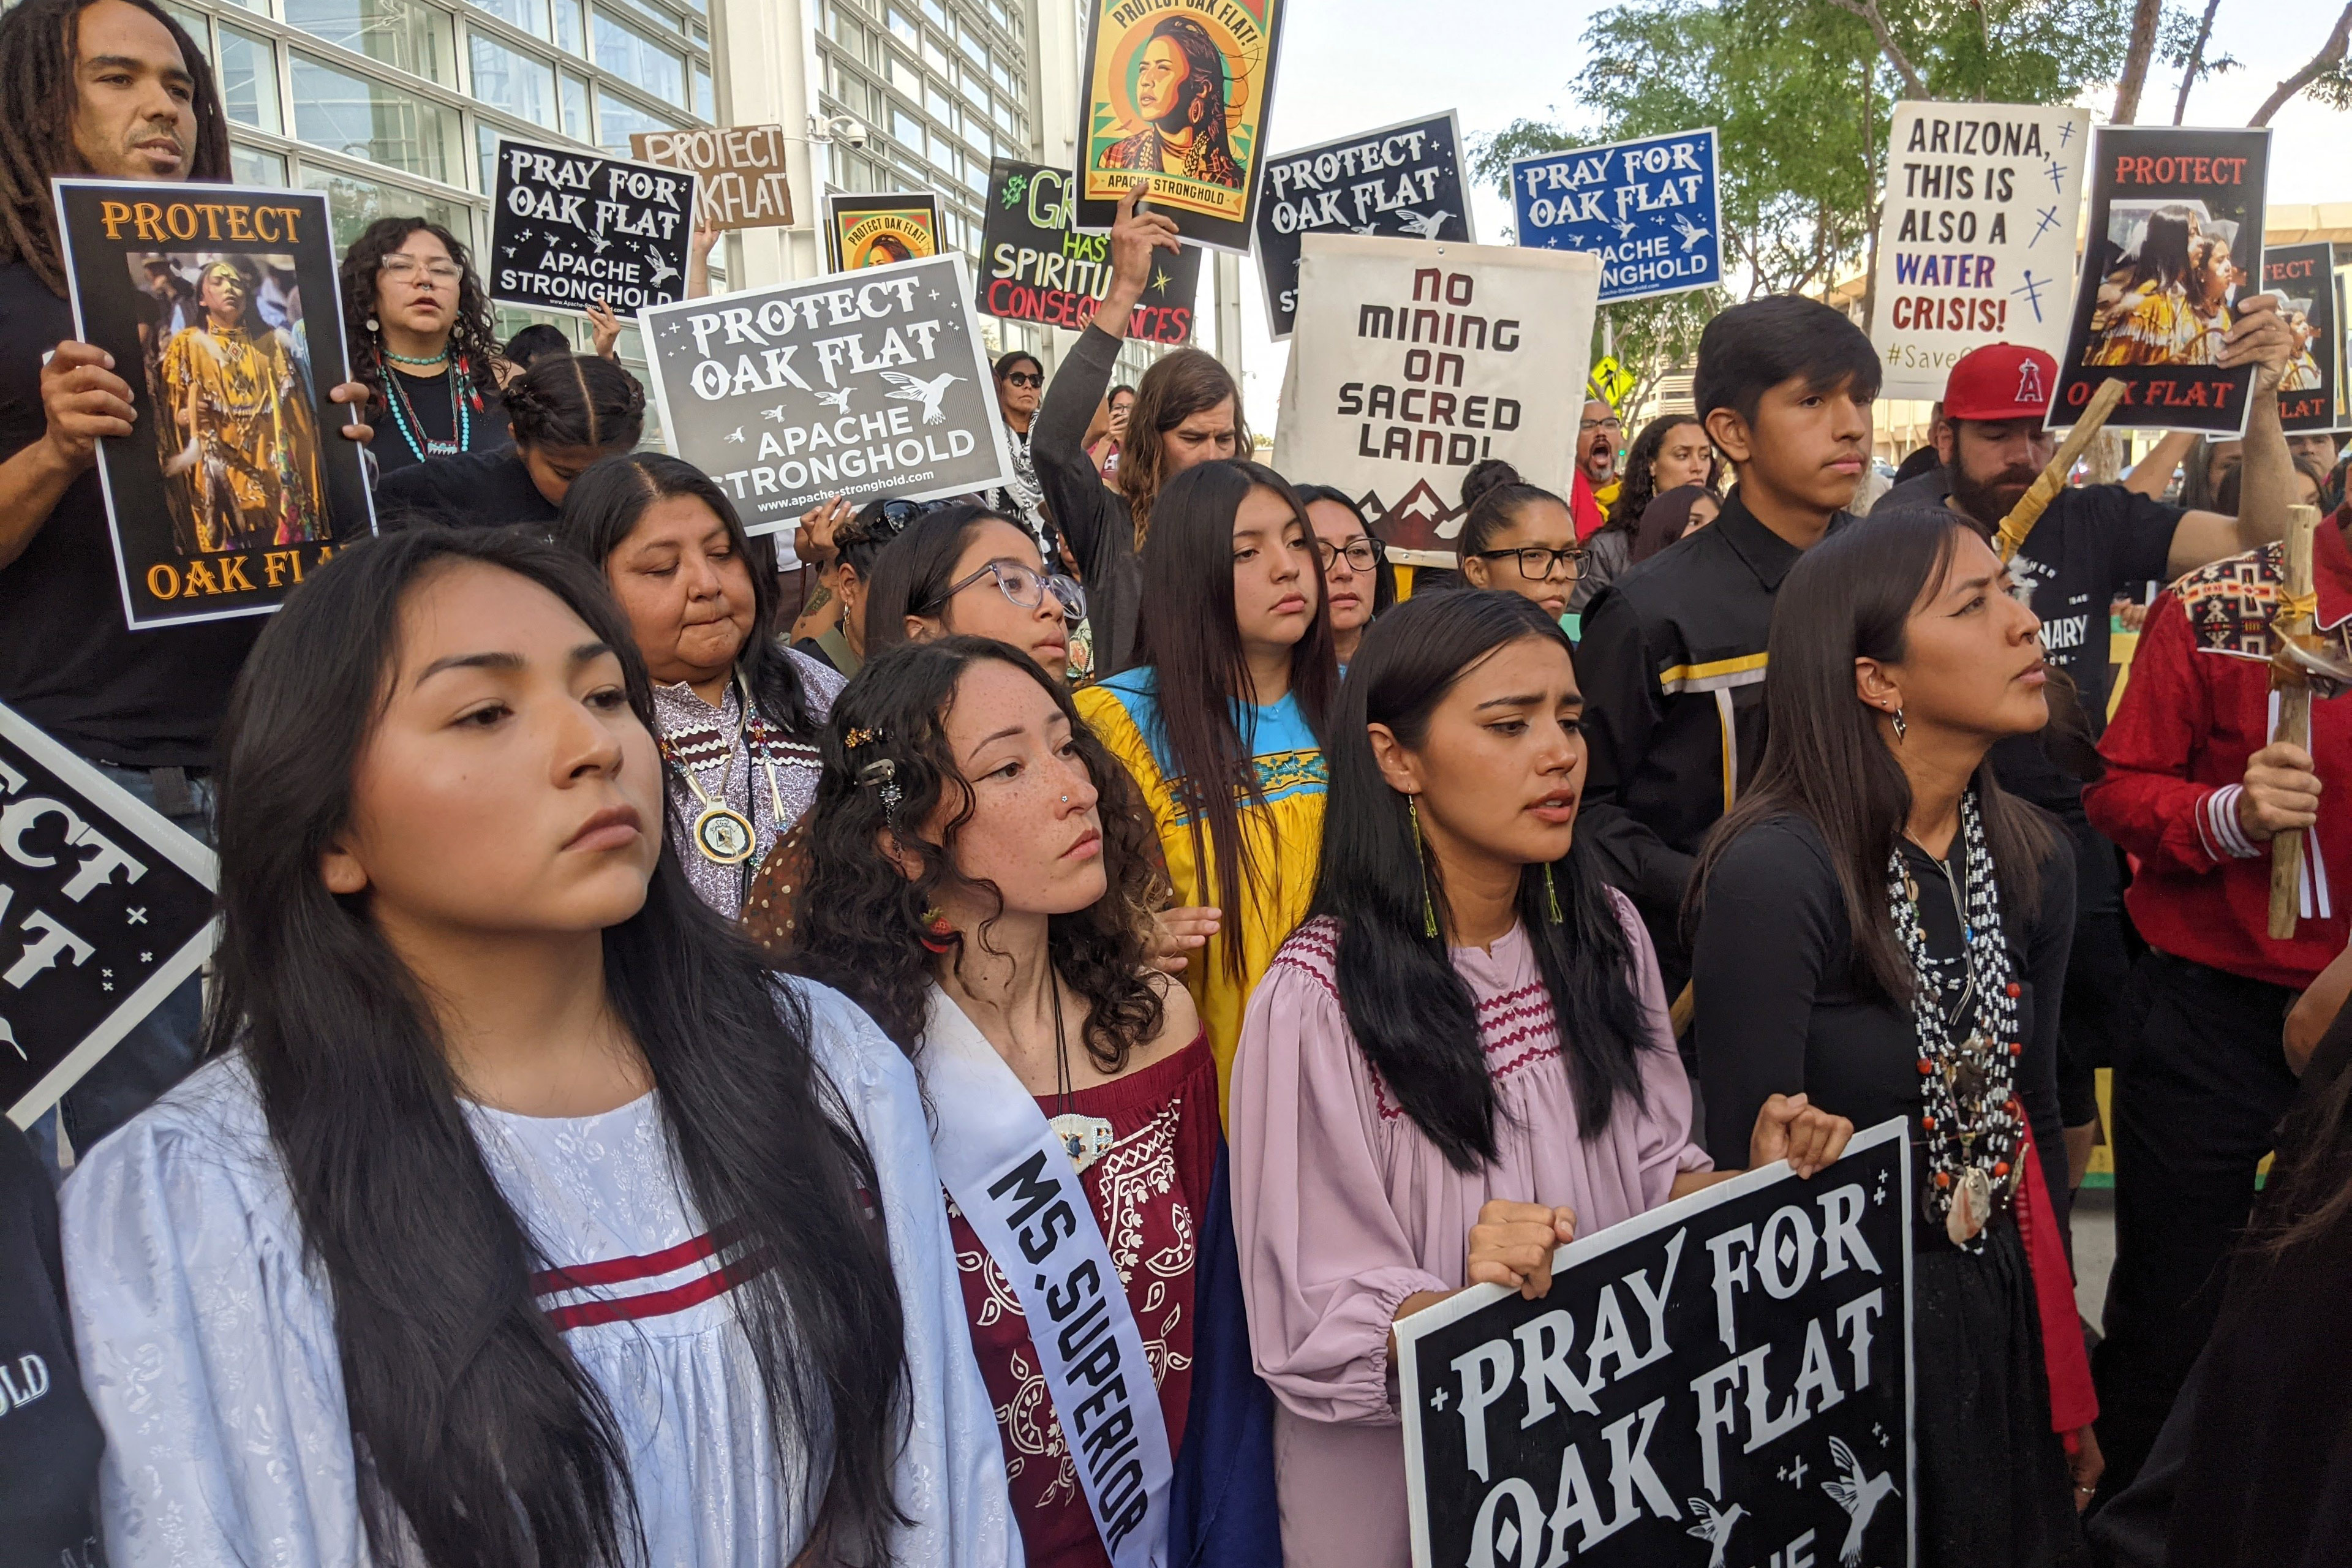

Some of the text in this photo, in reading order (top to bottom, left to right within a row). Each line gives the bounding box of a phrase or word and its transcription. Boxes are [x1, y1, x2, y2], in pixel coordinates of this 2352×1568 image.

[1217, 5, 1258, 47] FLAT!
[644, 125, 782, 170] PROTECT
[1907, 118, 2051, 162] ARIZONA,
[510, 149, 681, 211] PRAY FOR
[1270, 130, 1426, 201] PROTECT
[1524, 143, 1703, 199] PRAY FOR
[1903, 163, 2015, 202] THIS IS
[2115, 156, 2247, 186] PROTECT
[507, 186, 680, 240] OAK FLAT
[1154, 179, 1225, 205] STRONGHOLD
[1271, 166, 1439, 233] OAK FLAT
[1528, 174, 1703, 228] OAK FLAT
[101, 202, 301, 243] PROTECT
[848, 217, 927, 246] PROTECT OAK FLAT!
[1897, 209, 2007, 244] ALSO A
[539, 251, 641, 284] APACHE
[1063, 231, 1107, 263] HAS
[501, 270, 673, 306] STRONGHOLD
[992, 243, 1146, 309] SPIRITU
[1602, 254, 1708, 288] NGHOLD
[1896, 252, 1996, 288] WATER
[687, 276, 920, 359] PROTECT
[987, 279, 1190, 344] CONSEQNCES
[1892, 296, 2007, 333] CRISIS!
[690, 320, 941, 401] OAK FLAT
[1337, 382, 1521, 432] SACRED
[2146, 380, 2234, 409] FLAT
[2277, 399, 2326, 419] LAT
[758, 406, 913, 462] APACHE
[757, 469, 935, 513] www.apache-stronghold.com
[147, 556, 257, 600] OAK
[1451, 1183, 1882, 1483] PRAY FOR
[1046, 1259, 1148, 1561] SUPERIOR
[1466, 1287, 1883, 1568] OAK FLAT
